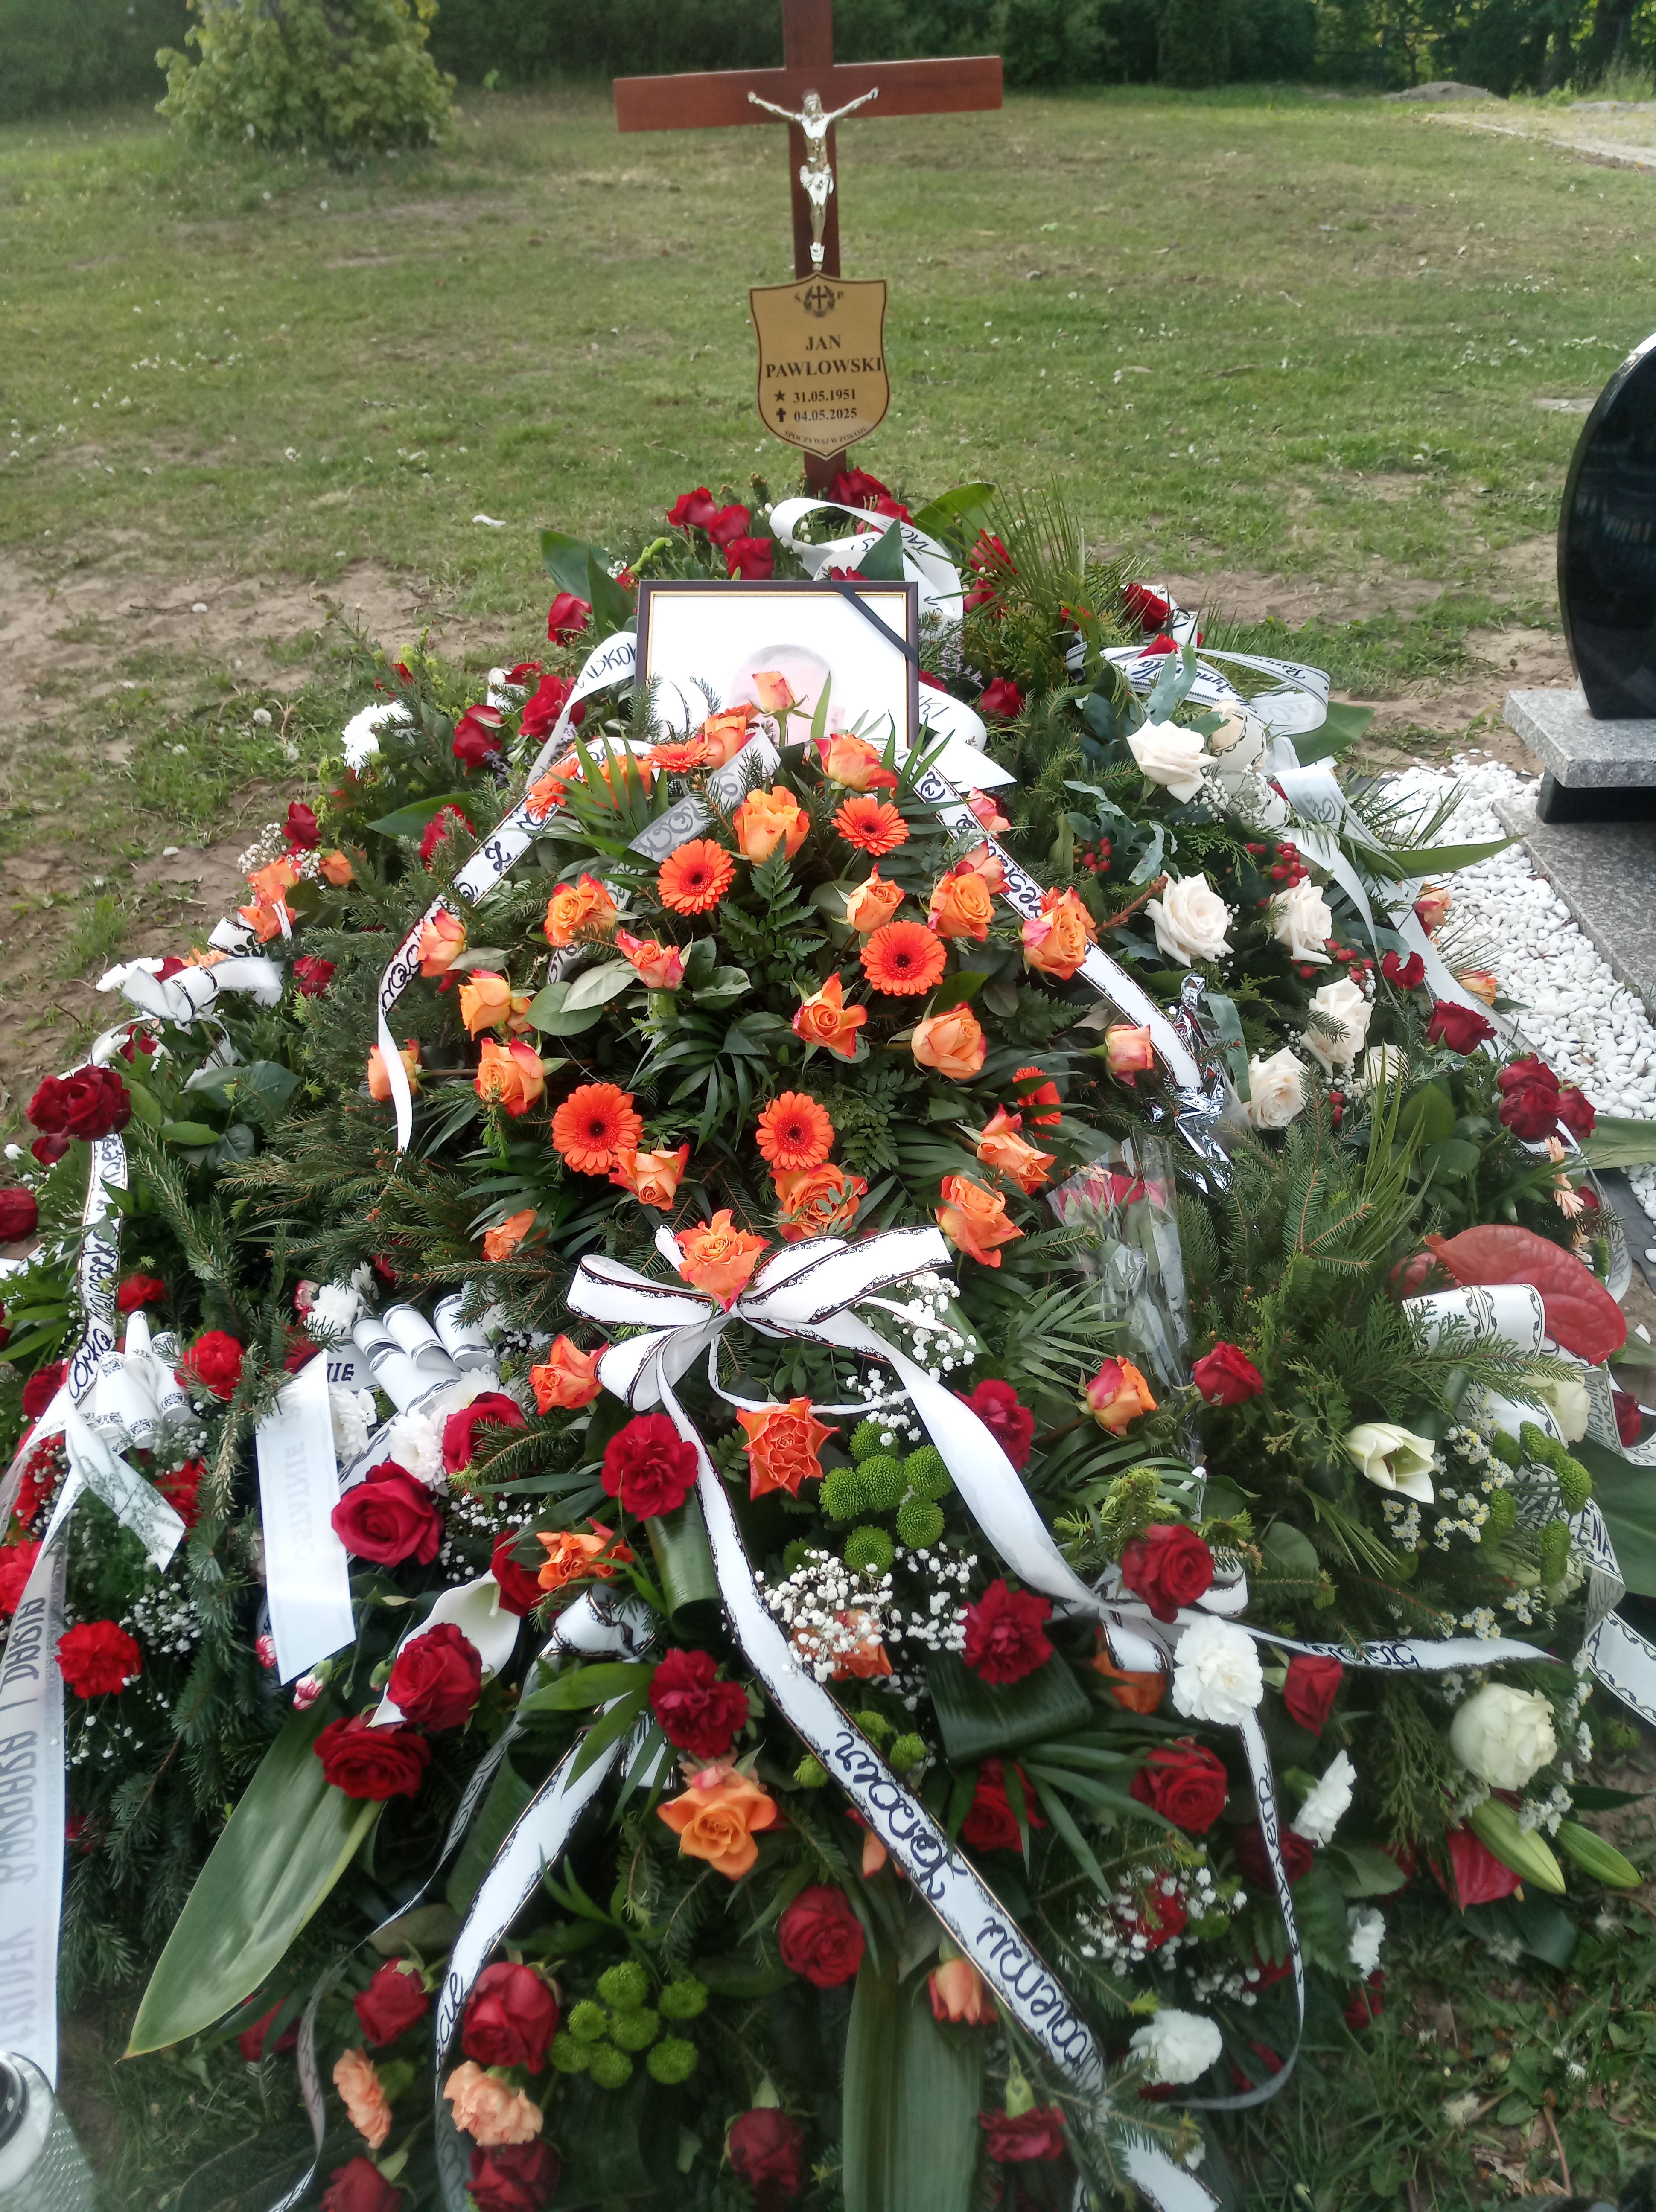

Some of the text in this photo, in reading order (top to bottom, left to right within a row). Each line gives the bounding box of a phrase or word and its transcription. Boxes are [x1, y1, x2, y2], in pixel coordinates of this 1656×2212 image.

[805, 335, 841, 350] JAN
[793, 389, 856, 403] 31.05.1951
[794, 408, 857, 422] 04.05.2025
[834, 1731, 968, 1901] Janowi
